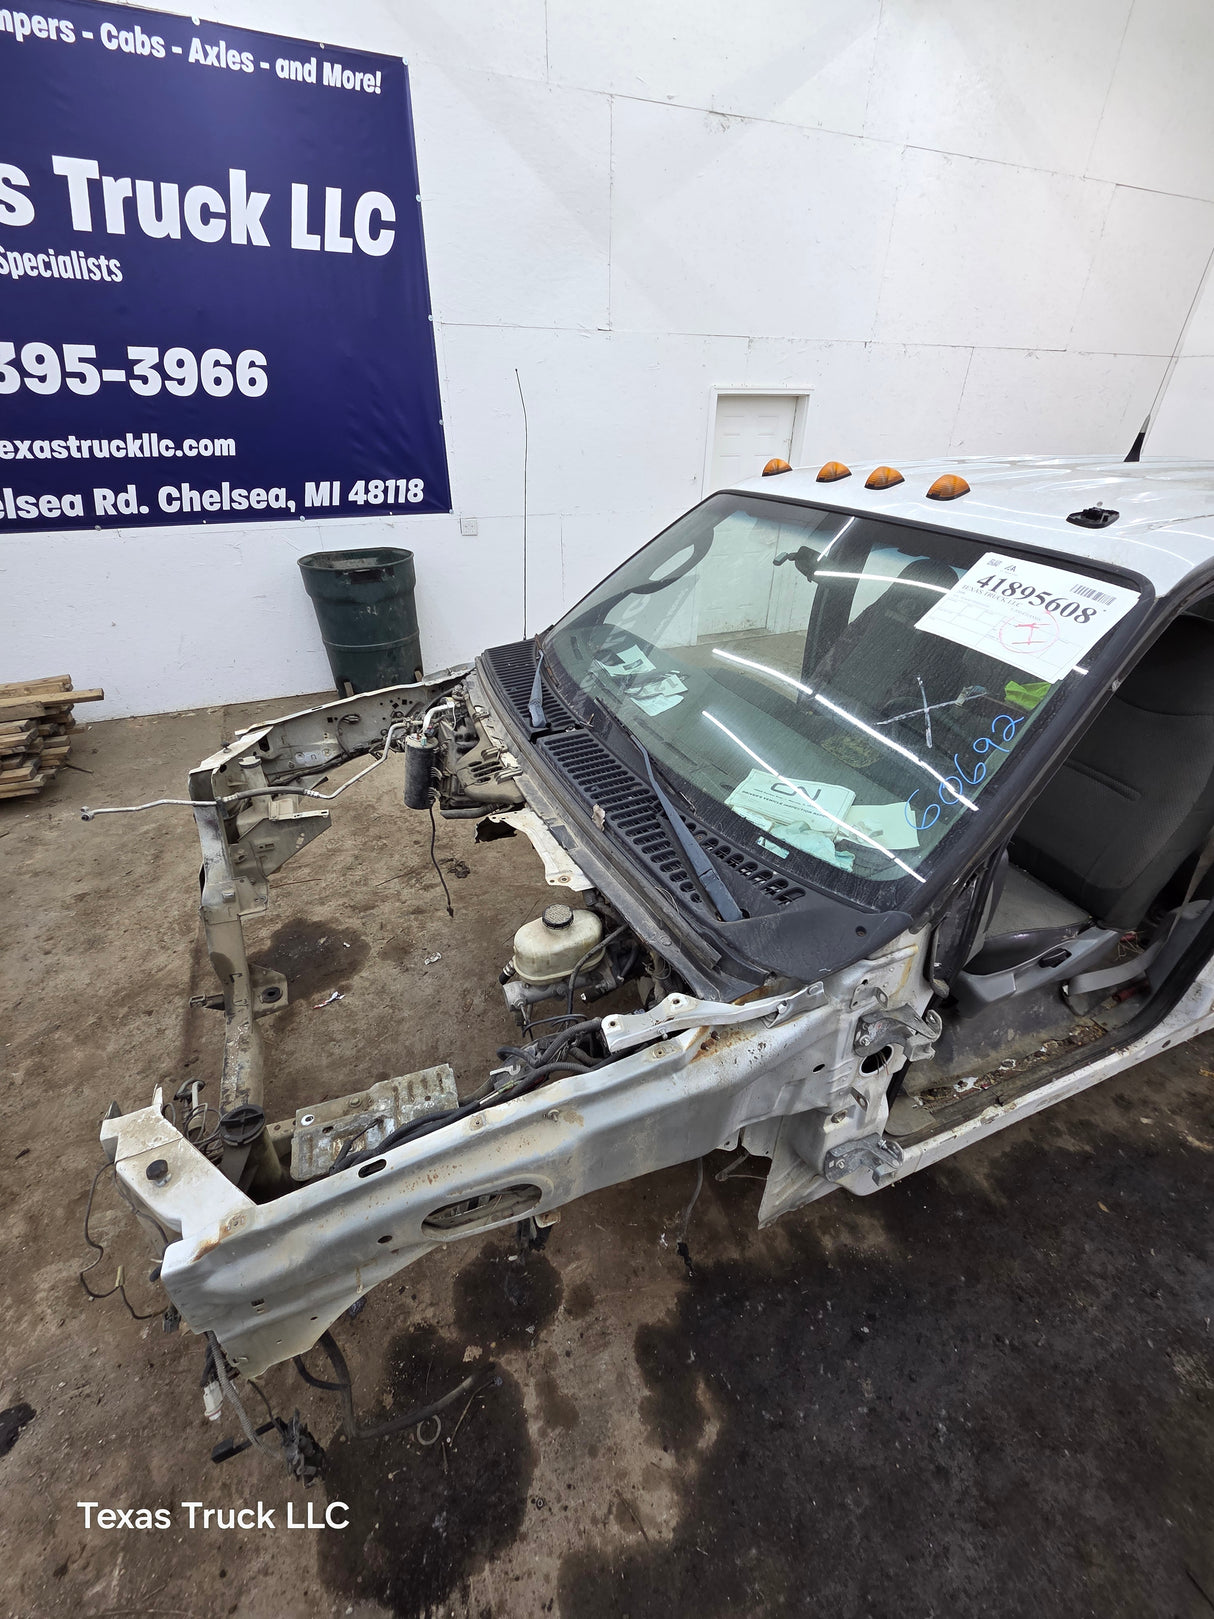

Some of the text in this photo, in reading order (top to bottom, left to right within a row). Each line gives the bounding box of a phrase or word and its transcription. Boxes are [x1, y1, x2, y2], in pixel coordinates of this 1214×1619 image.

[100, 22, 165, 58] Cabs
[189, 38, 254, 73] Axles
[276, 58, 316, 84] and
[322, 62, 382, 94] More!
[52, 155, 271, 247] Truck
[291, 182, 396, 257] LLC
[0, 479, 425, 518] lsea Rd. Chelsea, MI 48118
[976, 574, 1098, 625] 41895608
